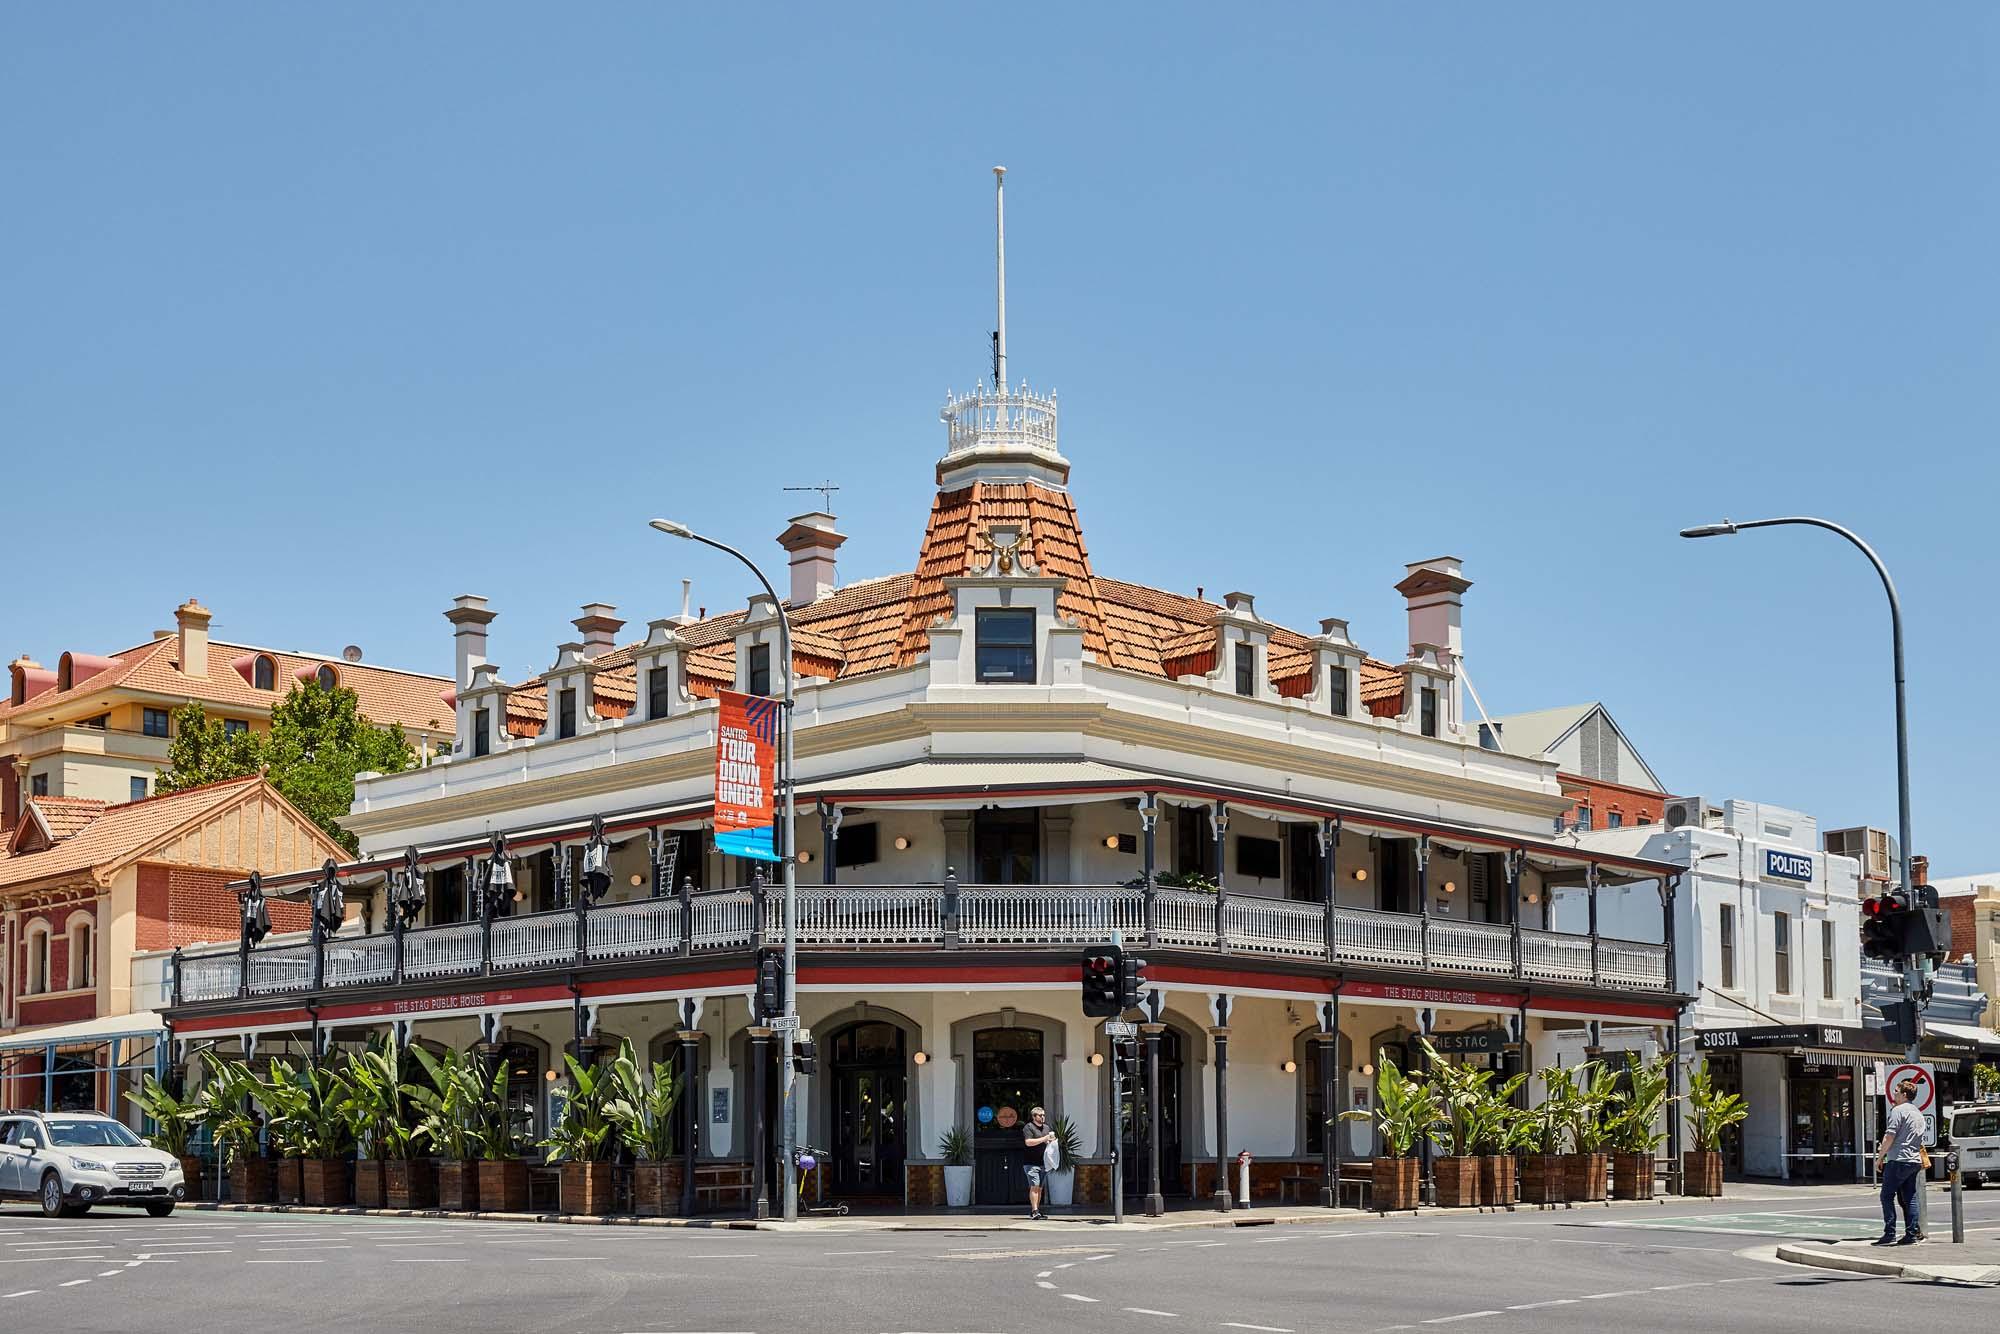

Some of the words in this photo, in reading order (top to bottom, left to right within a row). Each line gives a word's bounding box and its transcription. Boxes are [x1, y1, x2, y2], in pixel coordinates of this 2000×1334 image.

[721, 726, 748, 741] SANTOS
[720, 737, 756, 764] TOUR
[719, 759, 761, 787] DOWN
[718, 780, 763, 809] UNDER
[1770, 854, 1811, 877] POLITES
[1384, 987, 1399, 998] THE
[1402, 988, 1422, 999] STAG
[1424, 990, 1451, 1002] PUBLIC
[1452, 992, 1476, 1003] HOUSE
[394, 1002, 408, 1012] THE
[410, 1000, 429, 1011] STAG
[431, 997, 458, 1009] PUBLIC
[460, 995, 485, 1006] HOUSE
[1435, 1037, 1451, 1048] HE
[1455, 1036, 1488, 1048] STAG
[1703, 1032, 1739, 1047] SOSTA
[1824, 1029, 1843, 1044] SOSTA
